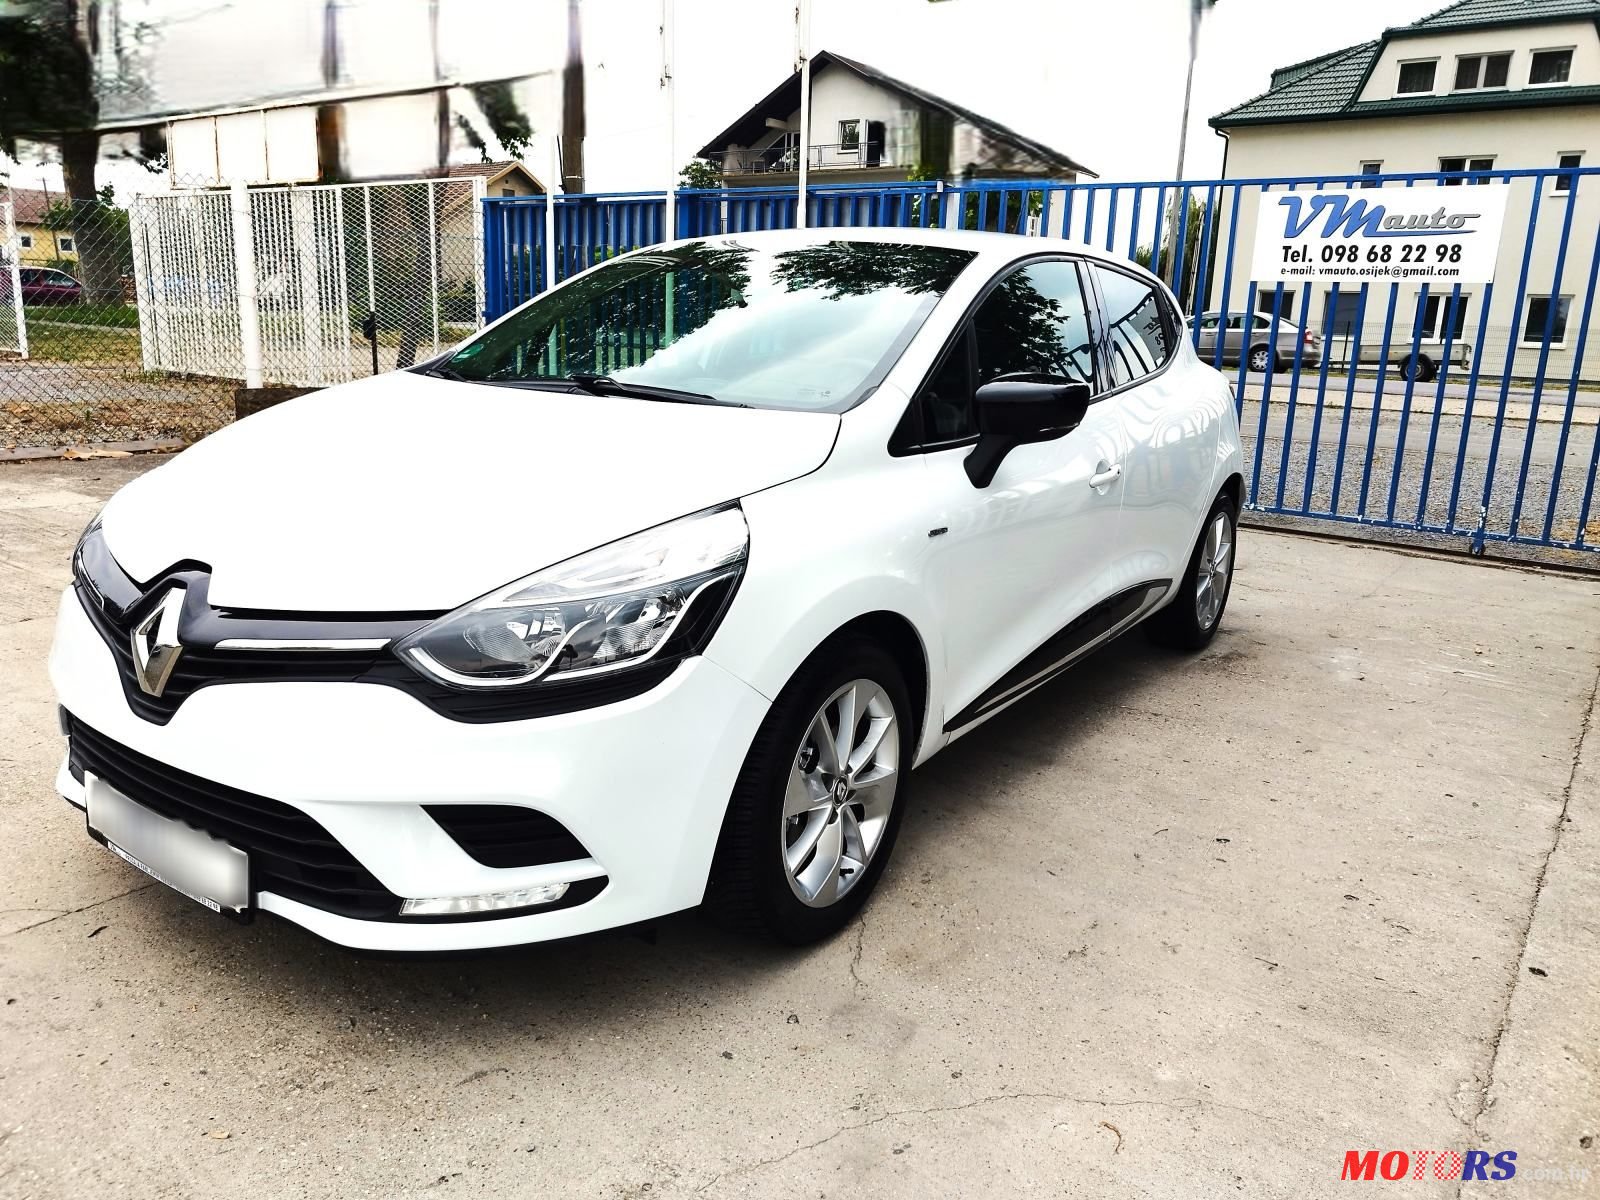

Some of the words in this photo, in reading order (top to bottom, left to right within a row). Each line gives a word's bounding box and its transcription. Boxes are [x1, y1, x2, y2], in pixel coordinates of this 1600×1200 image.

[1281, 245, 1313, 263] Tel.
[1320, 244, 1359, 263] 098
[1366, 244, 1393, 263] 68
[1400, 243, 1427, 262] 22
[1435, 243, 1463, 263] 98
[1280, 266, 1316, 276] e-mail:
[1318, 265, 1460, 278] vmauto.osijek@gmail.com
